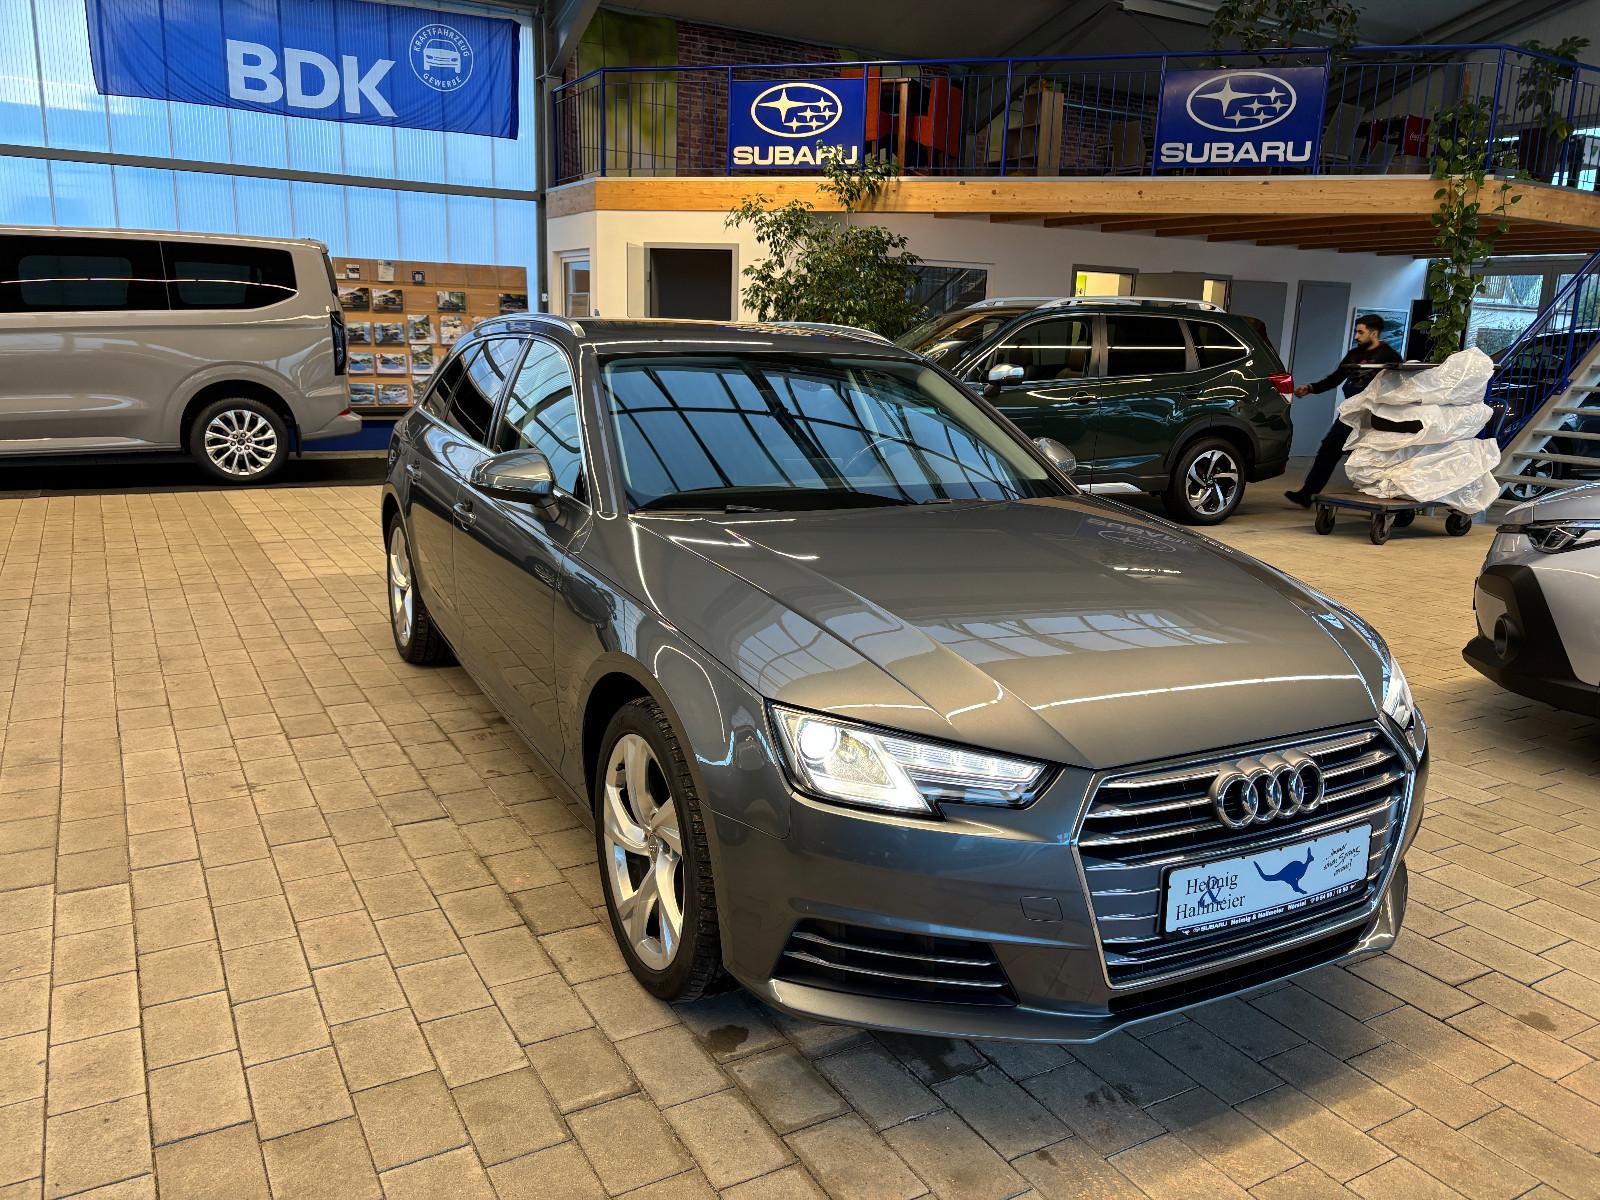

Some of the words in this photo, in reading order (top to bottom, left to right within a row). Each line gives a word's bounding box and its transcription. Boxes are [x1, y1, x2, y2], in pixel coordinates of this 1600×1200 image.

[414, 28, 469, 56] KRAFTFAHRZEUG
[226, 39, 398, 117] BDK
[424, 73, 461, 87] GEWERBE
[1161, 141, 1312, 163] SUBARU
[1175, 894, 1246, 920] Hallmeier
[1200, 921, 1228, 932] SUBARU
